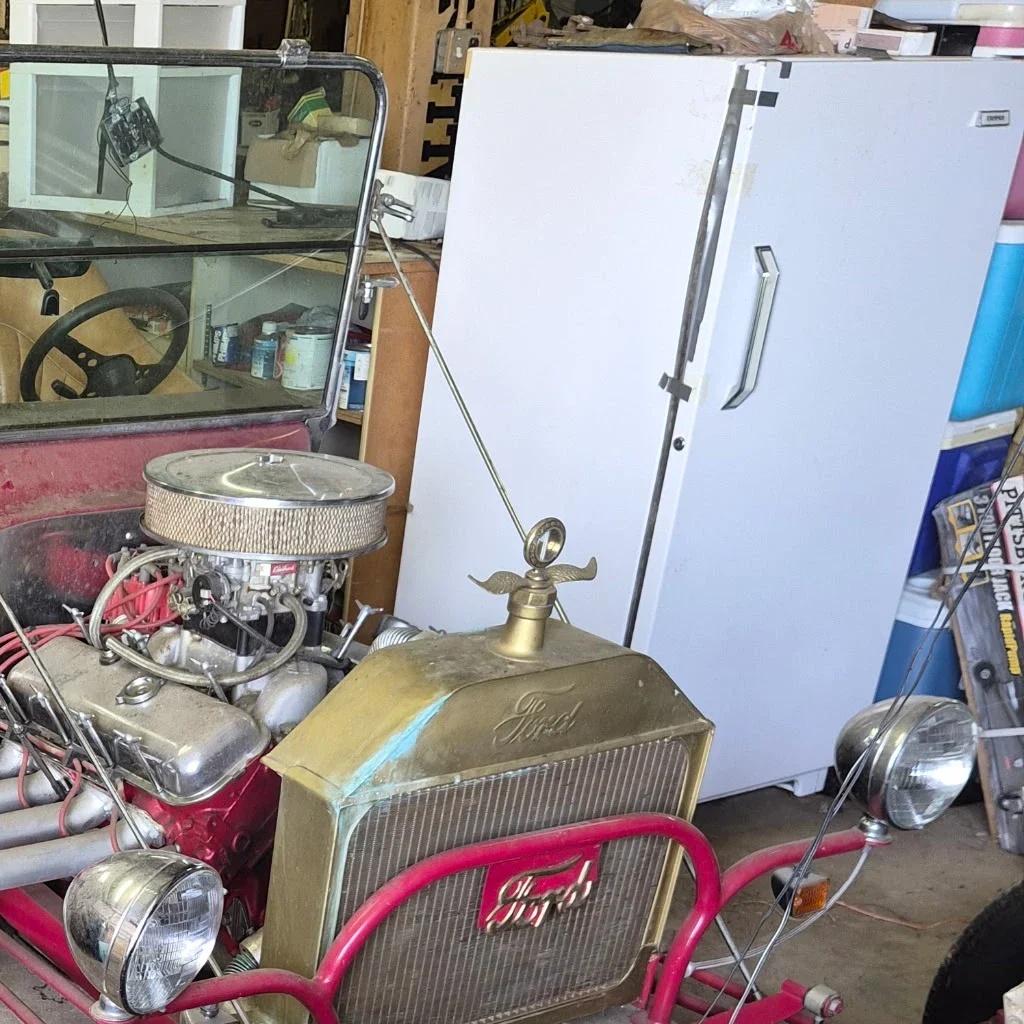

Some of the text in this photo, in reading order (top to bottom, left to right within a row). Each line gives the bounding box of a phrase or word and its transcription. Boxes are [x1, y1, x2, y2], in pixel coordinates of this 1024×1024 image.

[1001, 486, 1024, 589] PITTSB
[990, 575, 1014, 613] JACK
[492, 683, 583, 748] Ford
[485, 853, 593, 935] Ford
